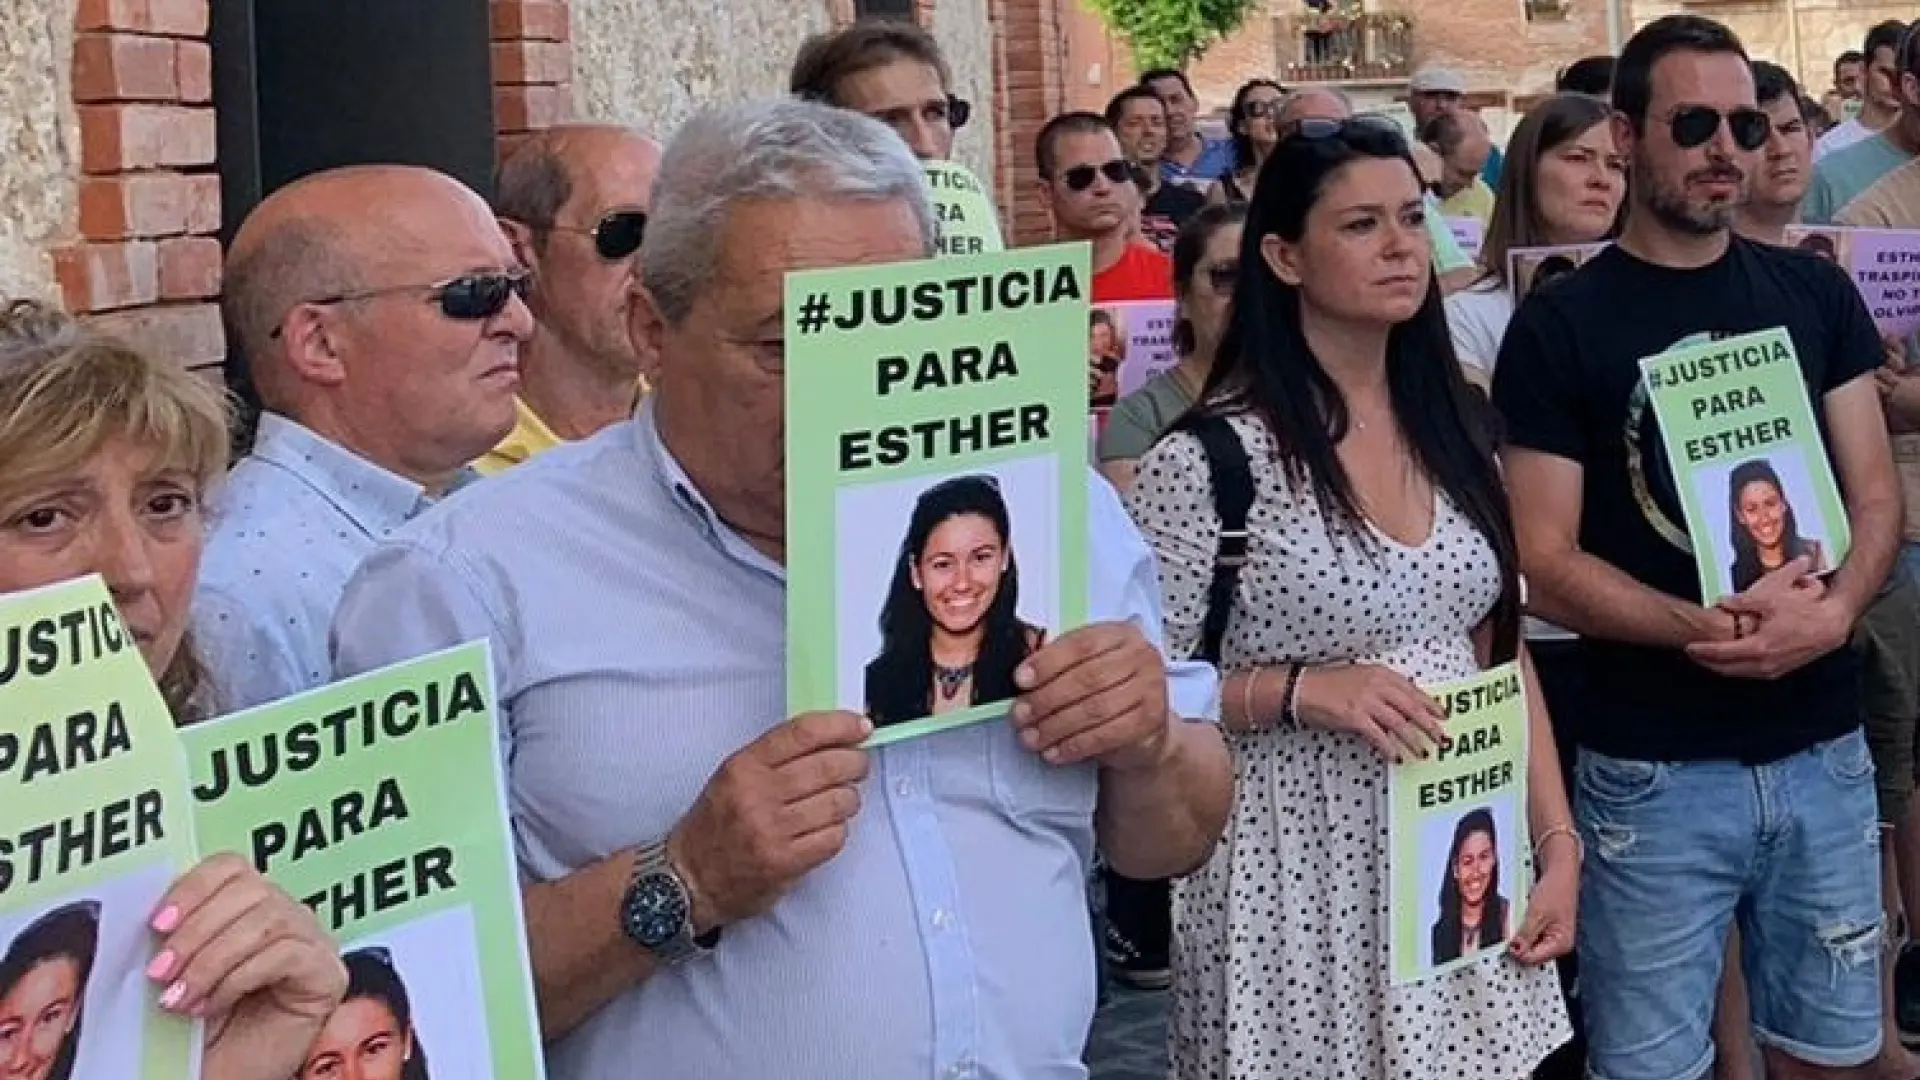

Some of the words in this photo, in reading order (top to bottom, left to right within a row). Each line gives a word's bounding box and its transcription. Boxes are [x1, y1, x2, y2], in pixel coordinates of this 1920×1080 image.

[797, 264, 1080, 334] #JUSTICIA
[877, 341, 1018, 396] PARA
[1691, 386, 1766, 421] PARA
[839, 403, 1050, 471] ESTHER
[1686, 416, 1793, 462] ESTHER
[0, 602, 131, 685] USTIC
[192, 671, 486, 801] JUSTICIA
[1438, 724, 1502, 762] PARA
[1418, 760, 1513, 808] ESTHER
[251, 777, 409, 874] PARA
